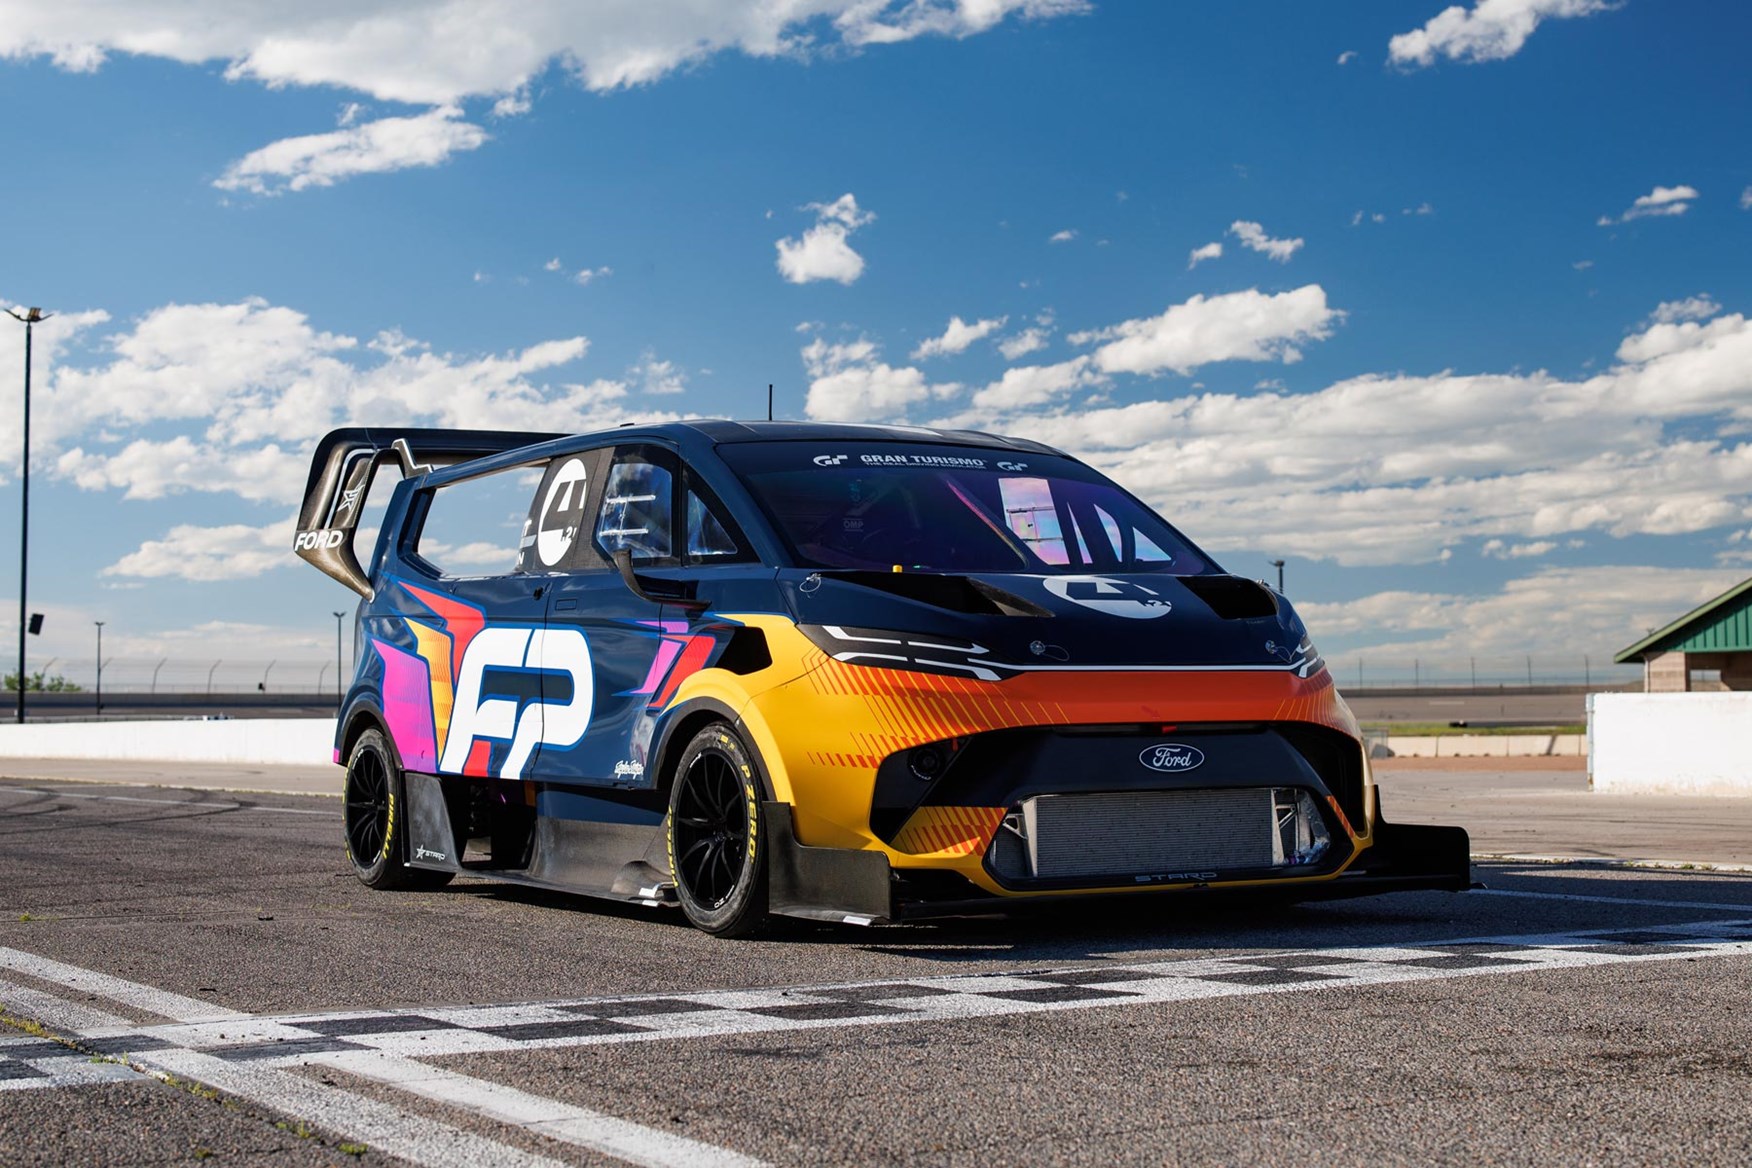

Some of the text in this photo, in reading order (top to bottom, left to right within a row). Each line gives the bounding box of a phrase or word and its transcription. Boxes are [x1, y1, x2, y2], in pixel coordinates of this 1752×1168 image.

[860, 454, 984, 466] GRAN TURISMO
[843, 520, 864, 529] OMP
[294, 530, 344, 551] FORD
[439, 627, 594, 781] FP
[1153, 747, 1192, 767] Ford
[741, 765, 757, 858] P ZERO
[382, 792, 395, 859] PIRELLI
[1135, 872, 1217, 882] STARD
